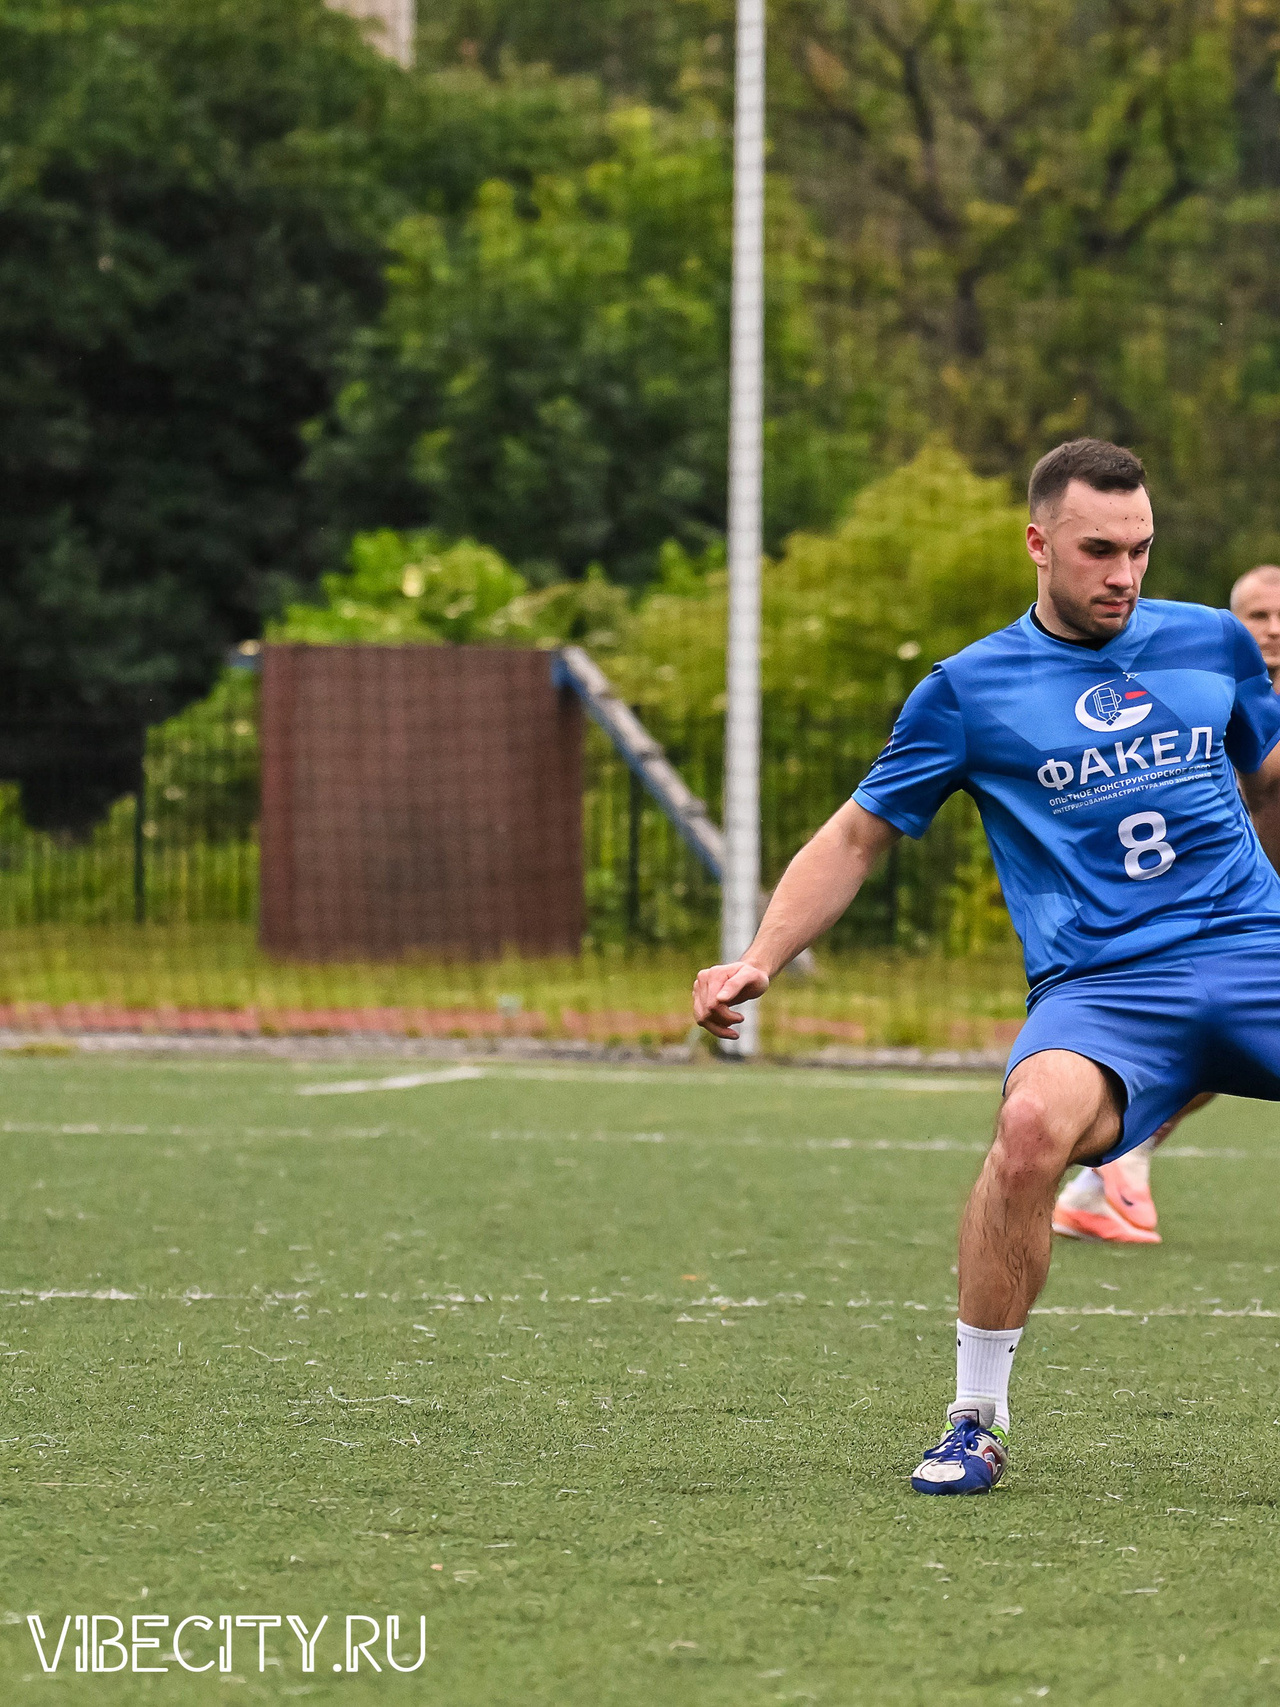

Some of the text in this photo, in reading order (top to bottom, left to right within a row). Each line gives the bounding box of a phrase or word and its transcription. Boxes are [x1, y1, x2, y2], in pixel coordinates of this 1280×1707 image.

[1037, 726, 1213, 792] ФАКЕЛ
[1049, 789, 1093, 807] ОПЫТНОЕ
[1118, 783, 1158, 797] СТРУКТУРА
[1118, 811, 1176, 881] 8
